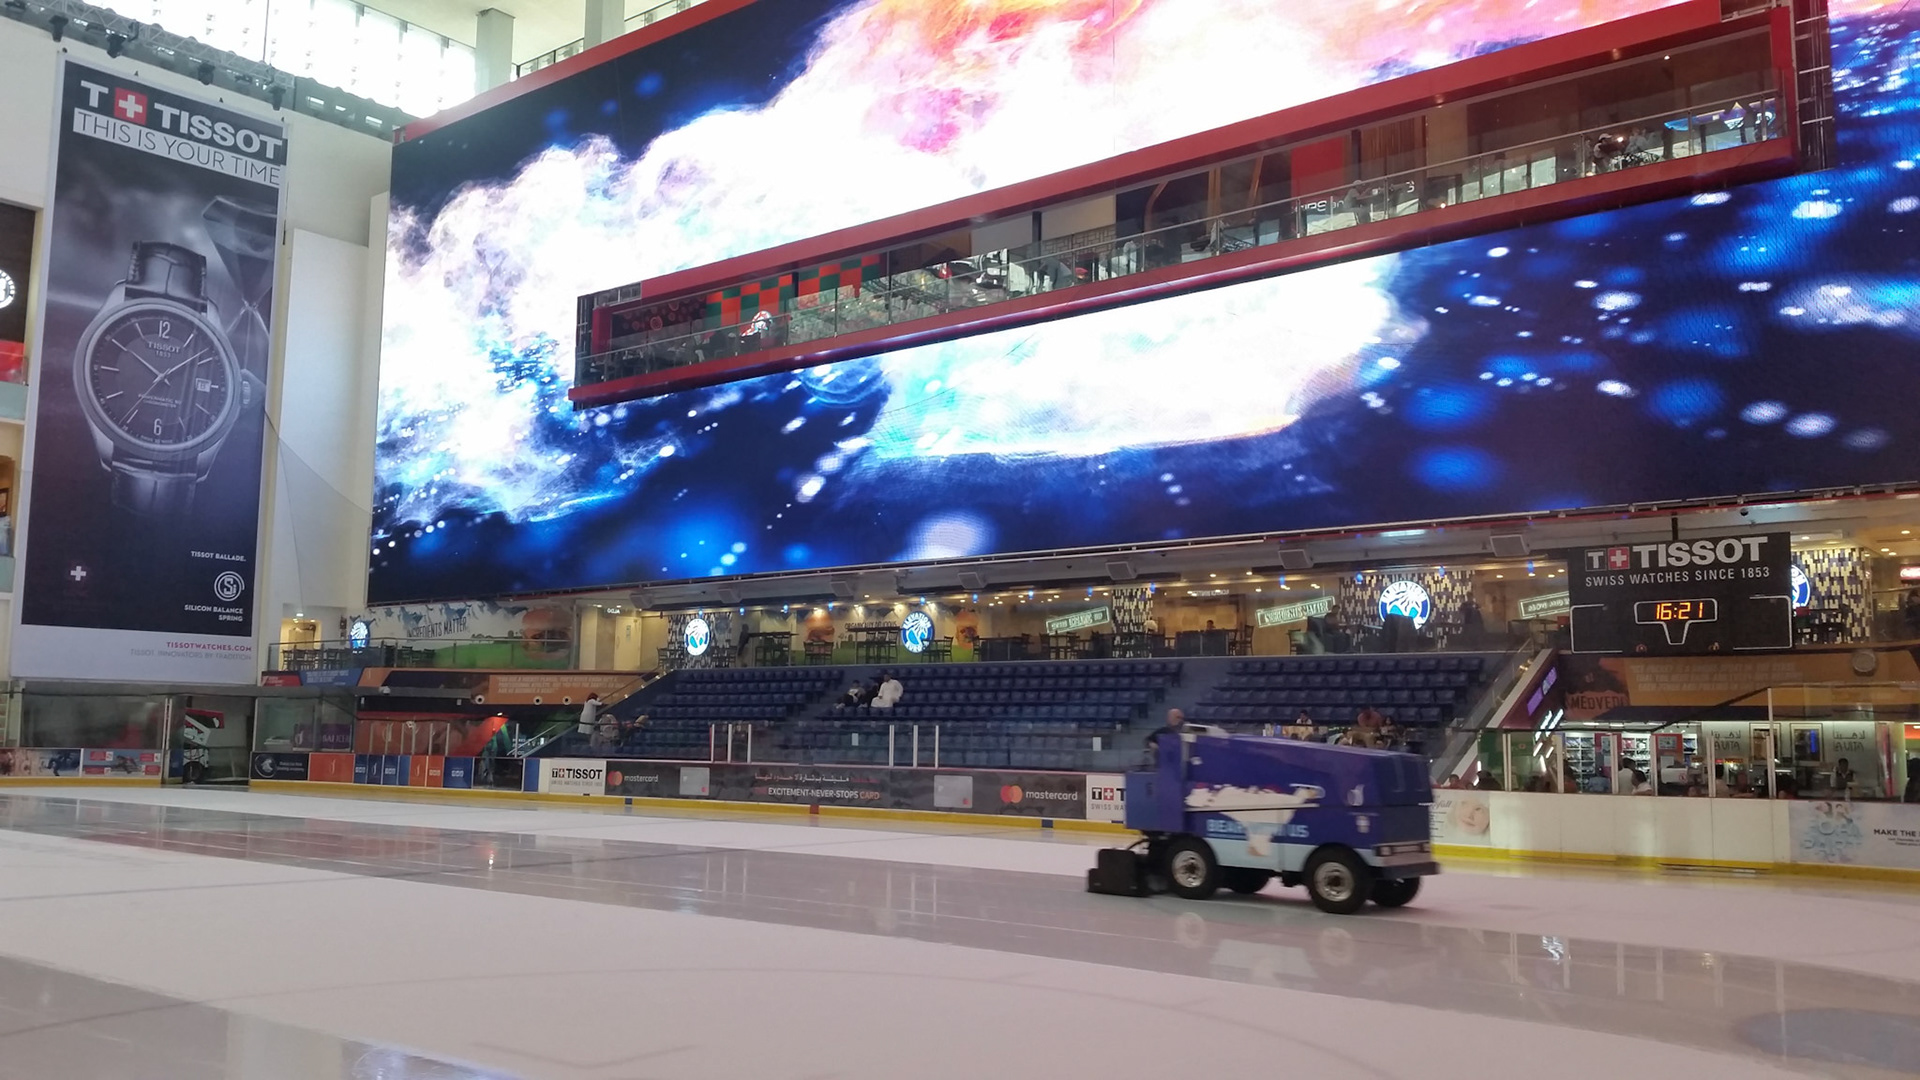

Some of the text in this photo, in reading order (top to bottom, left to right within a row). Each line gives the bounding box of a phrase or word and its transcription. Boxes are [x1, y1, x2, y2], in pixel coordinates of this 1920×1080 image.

[80, 80, 283, 160] T TISSOT
[78, 111, 281, 186] THIS IS YOUR TIME
[158, 320, 172, 339] 12
[153, 418, 162, 436] 6
[190, 550, 214, 559] TISSOT
[1633, 536, 1768, 569] TISSOT
[1585, 566, 1771, 587] SWISS WATCHES SINCE 1853
[184, 604, 244, 614] SILICON BALANCE
[1656, 602, 1703, 620] 16:21
[166, 642, 252, 652] TISSOTWATCHES.COM
[566, 768, 603, 780] TISSOT
[624, 774, 659, 783] mastercard
[768, 787, 859, 799] EXCITEMENT-NEVER-STOPS
[860, 791, 880, 799] CARD
[1026, 790, 1078, 801] mastercard
[1873, 828, 1898, 836] MAKE
